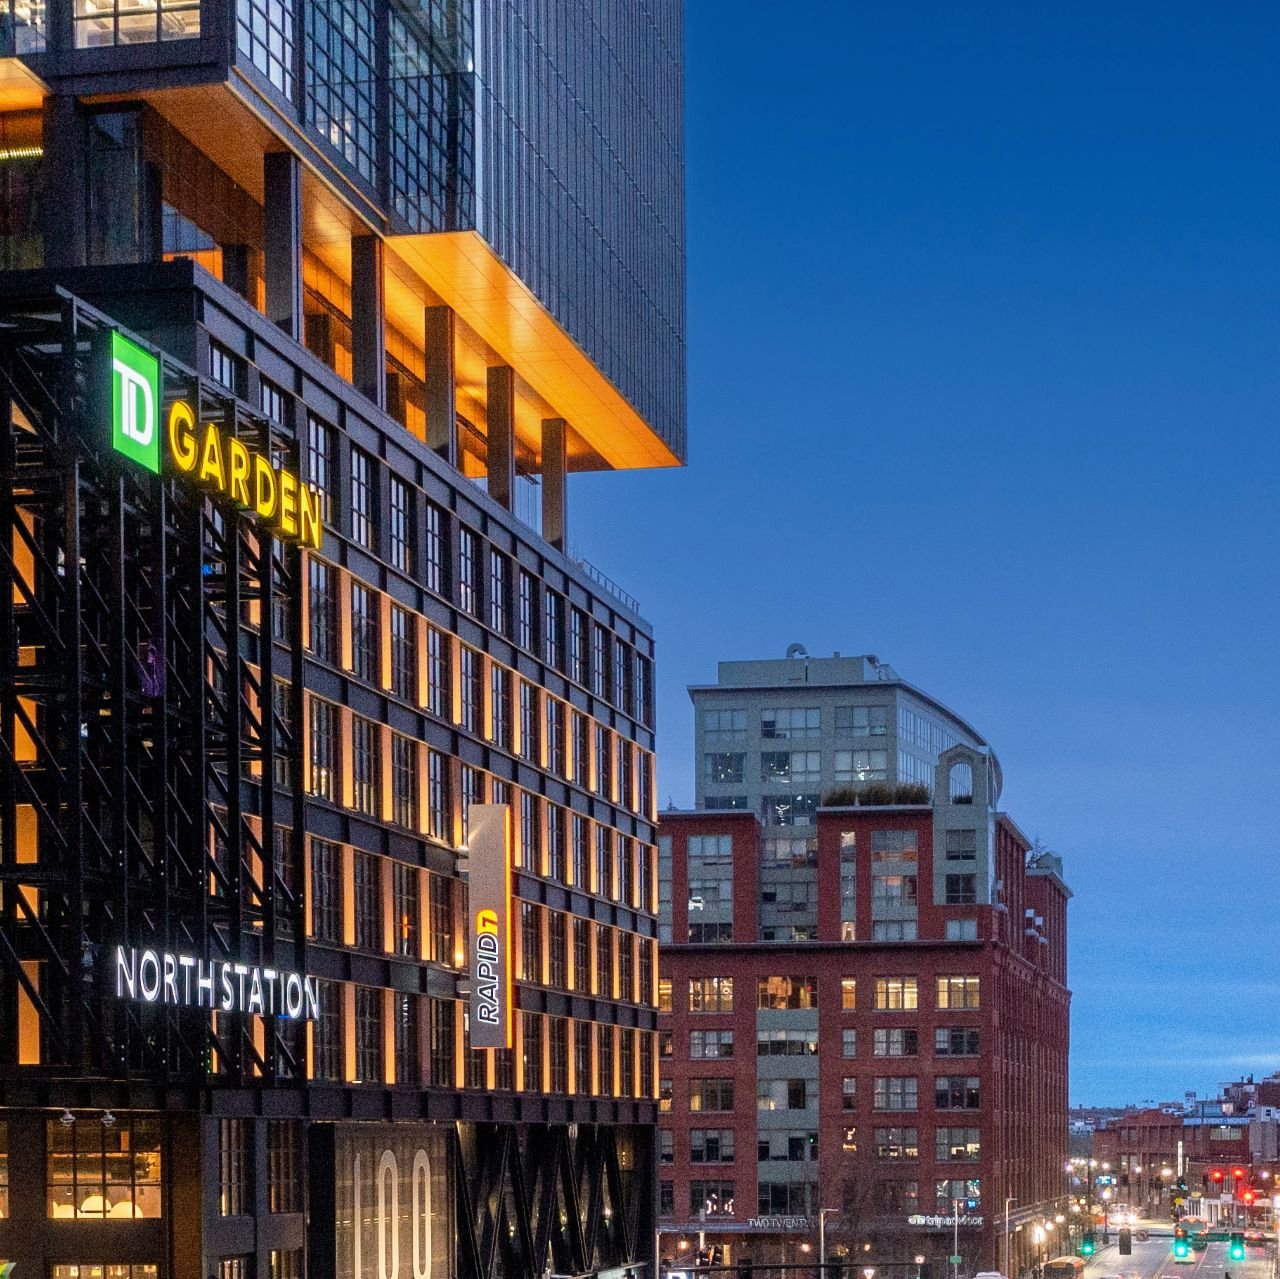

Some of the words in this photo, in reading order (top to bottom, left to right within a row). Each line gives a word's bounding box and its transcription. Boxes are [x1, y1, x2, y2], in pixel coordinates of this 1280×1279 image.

[114, 358, 154, 446] TD
[169, 400, 322, 550] GARDEN
[117, 945, 216, 1009] NORTH
[221, 962, 319, 1020] STATION
[476, 909, 499, 1025] RAPID7
